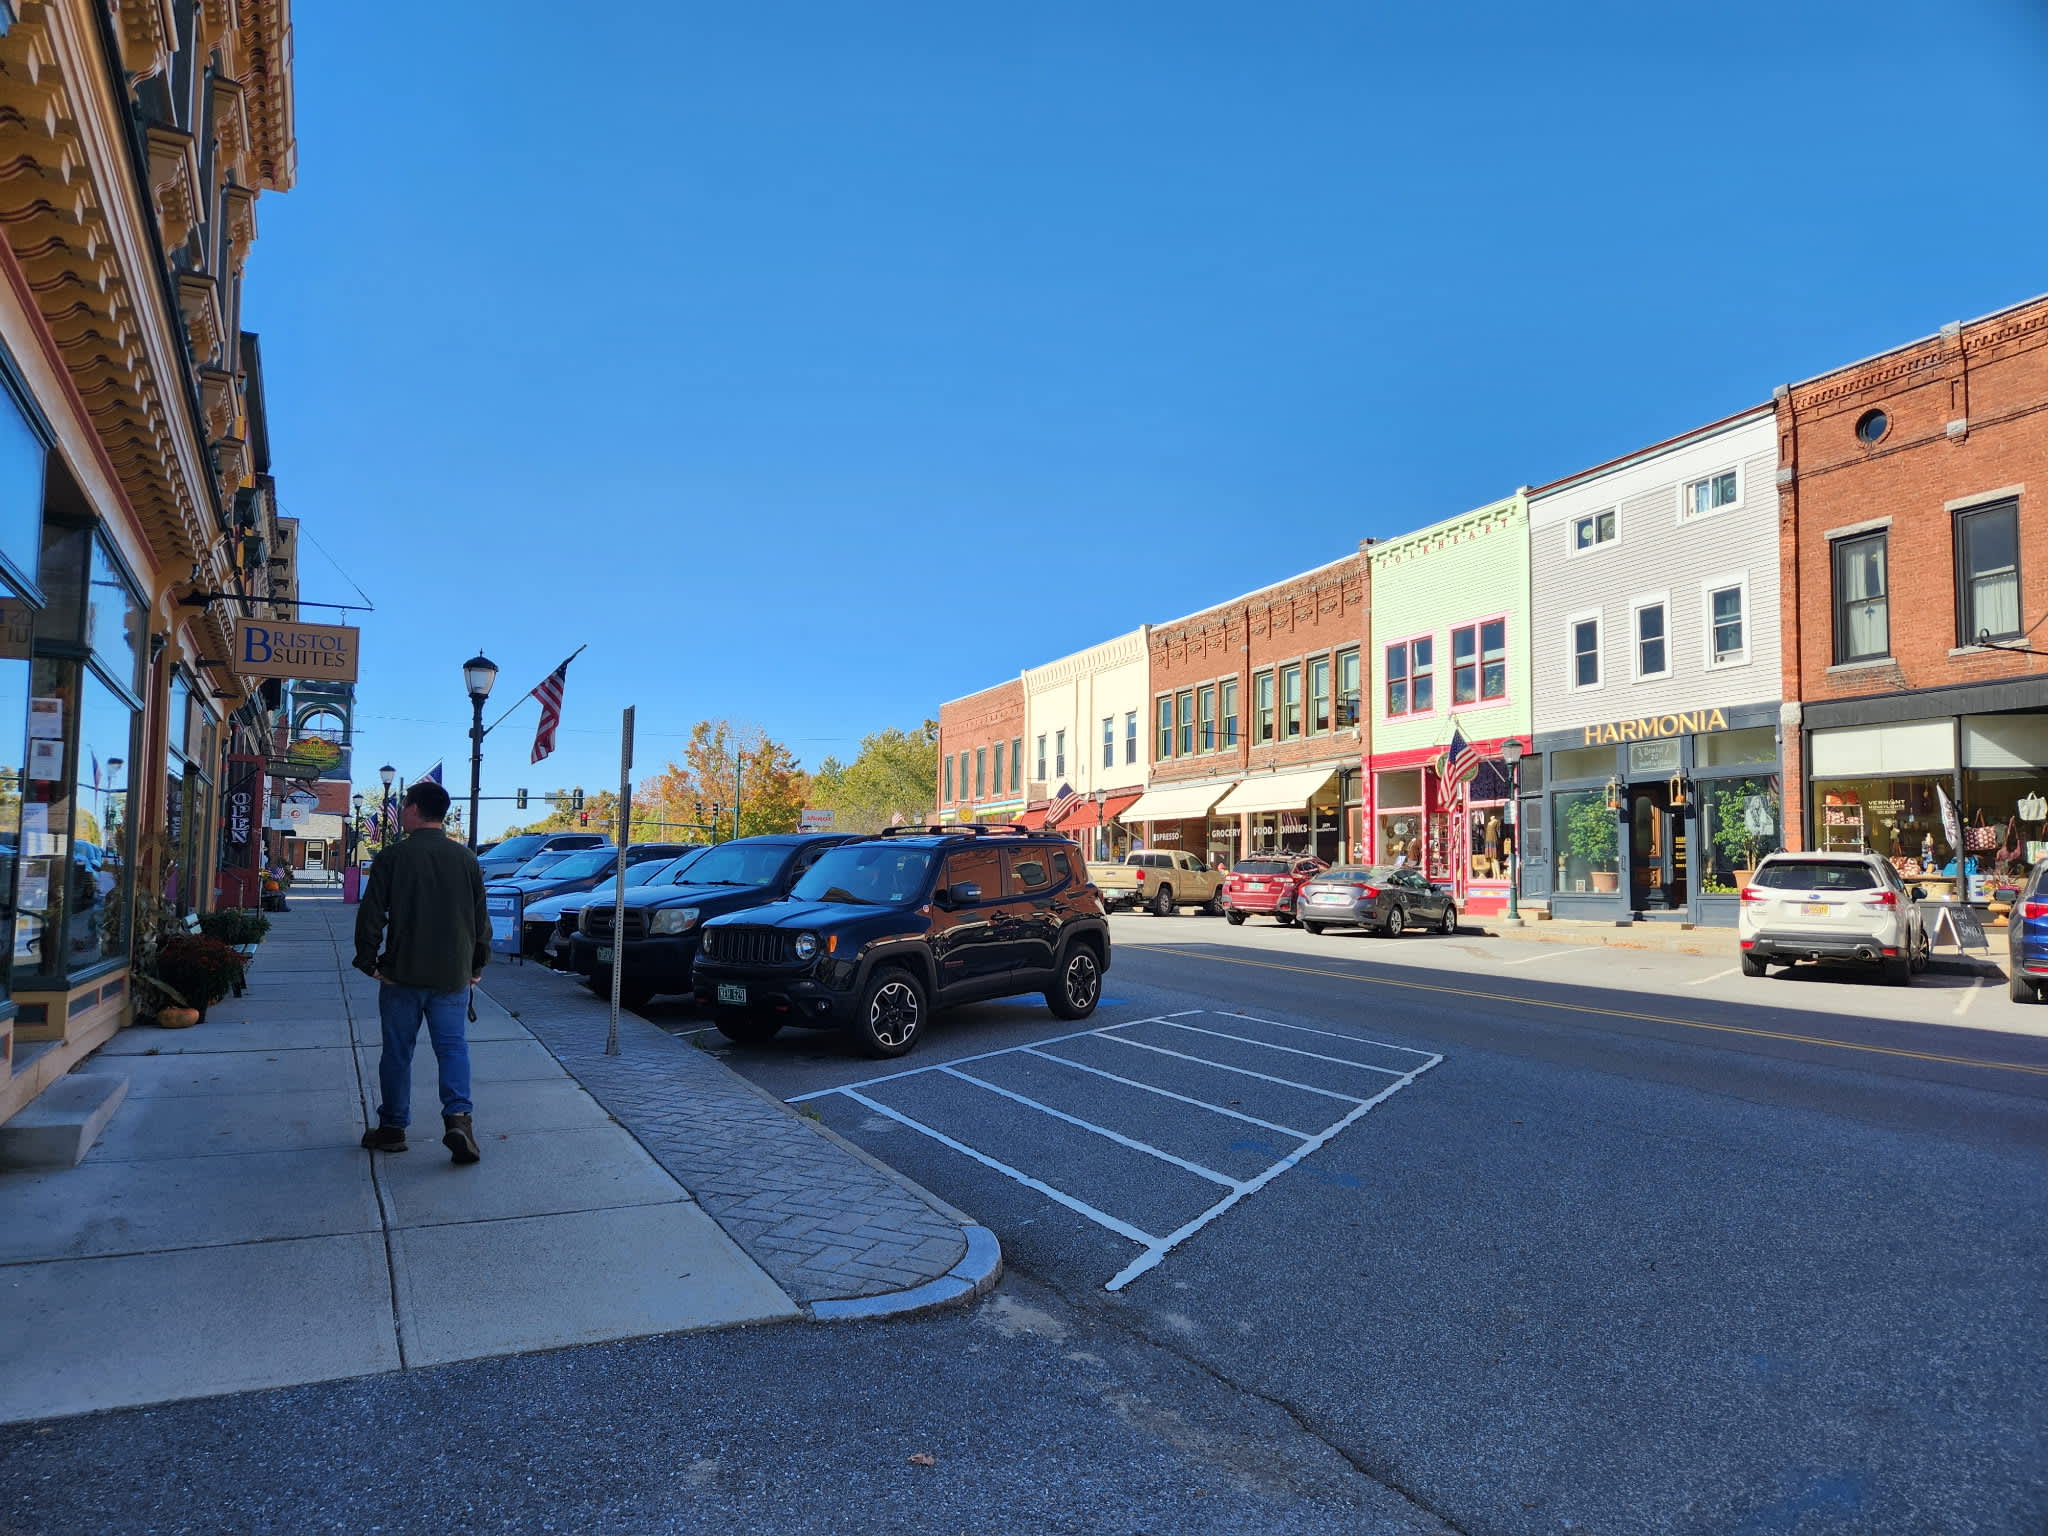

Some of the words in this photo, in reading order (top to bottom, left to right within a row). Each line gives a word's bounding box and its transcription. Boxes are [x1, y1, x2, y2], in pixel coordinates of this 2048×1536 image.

[242, 627, 347, 662] BRISTOL
[273, 648, 345, 667] SUITES
[1584, 708, 1728, 745] HARMONIA
[231, 792, 251, 843] OPEN
[1153, 832, 1179, 841] ESPRESSO
[1211, 828, 1240, 838] GROCERY
[1253, 826, 1273, 836] FOOD
[1280, 824, 1307, 834] DRINKS
